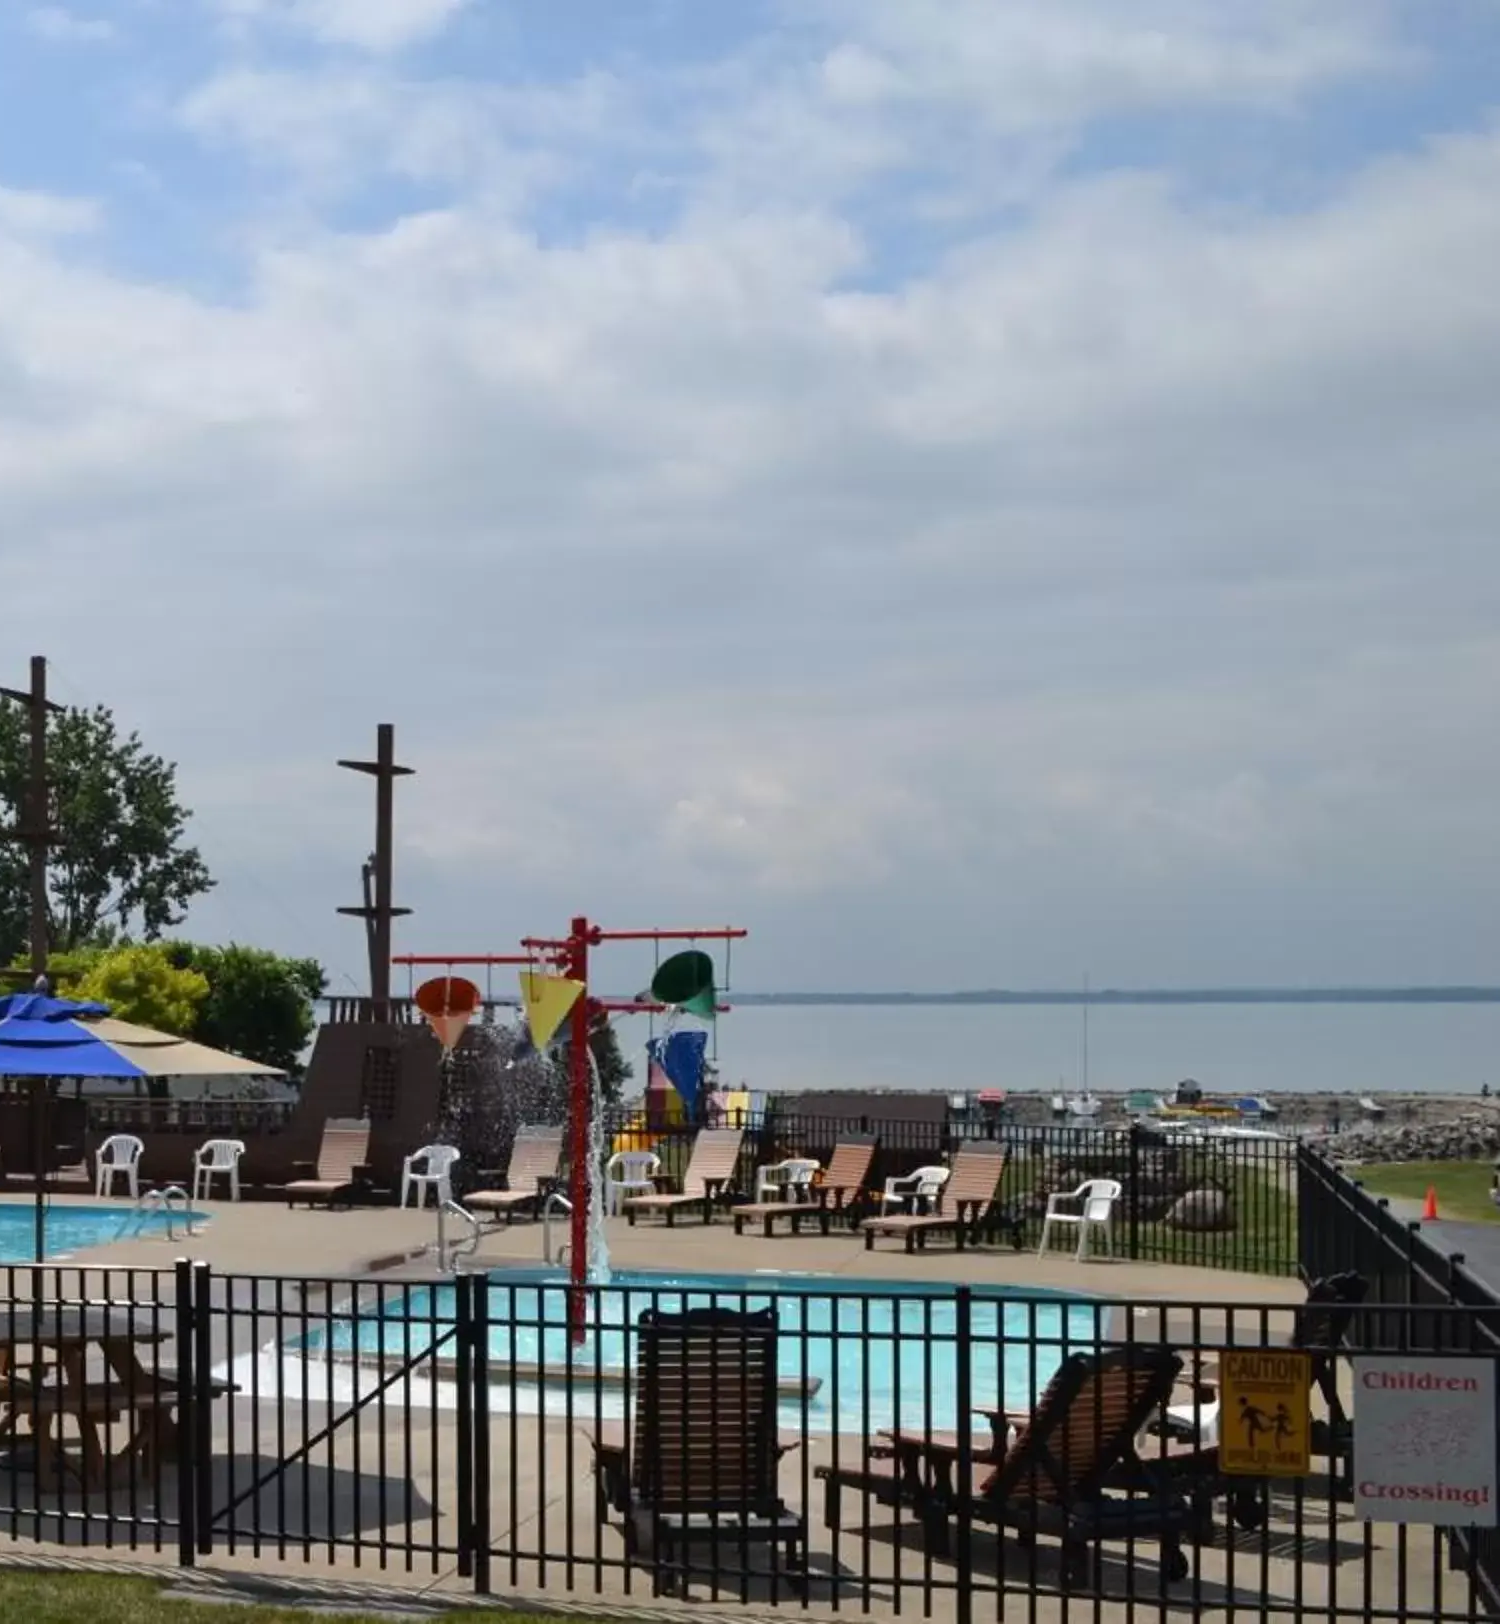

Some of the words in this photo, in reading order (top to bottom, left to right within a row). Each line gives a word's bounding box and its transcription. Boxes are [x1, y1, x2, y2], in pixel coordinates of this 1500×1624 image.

[1227, 1356, 1302, 1381] CAUTION
[1363, 1371, 1479, 1393] Children
[1359, 1481, 1490, 1507] Crossing!
